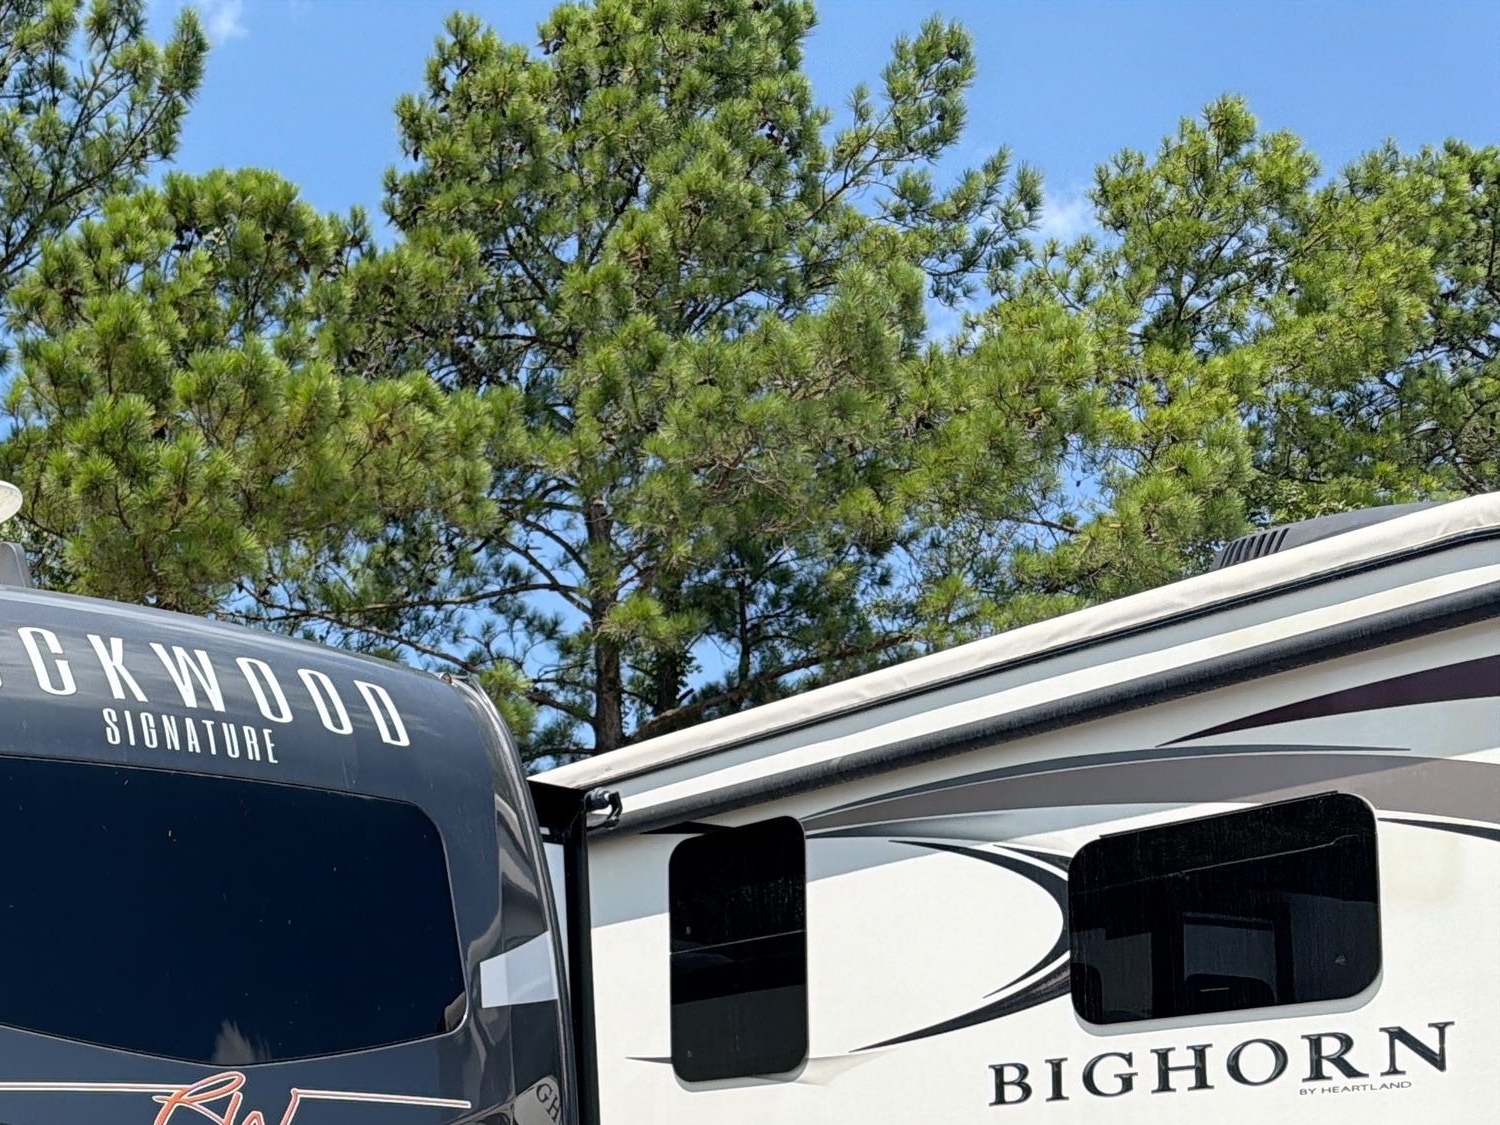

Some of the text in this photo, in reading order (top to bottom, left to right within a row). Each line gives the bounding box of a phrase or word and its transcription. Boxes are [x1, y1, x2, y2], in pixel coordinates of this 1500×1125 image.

[102, 707, 279, 764] SIGNATURE
[988, 1021, 1455, 1107] BIGHORN
[1321, 1081, 1412, 1094] HEARTLAND
